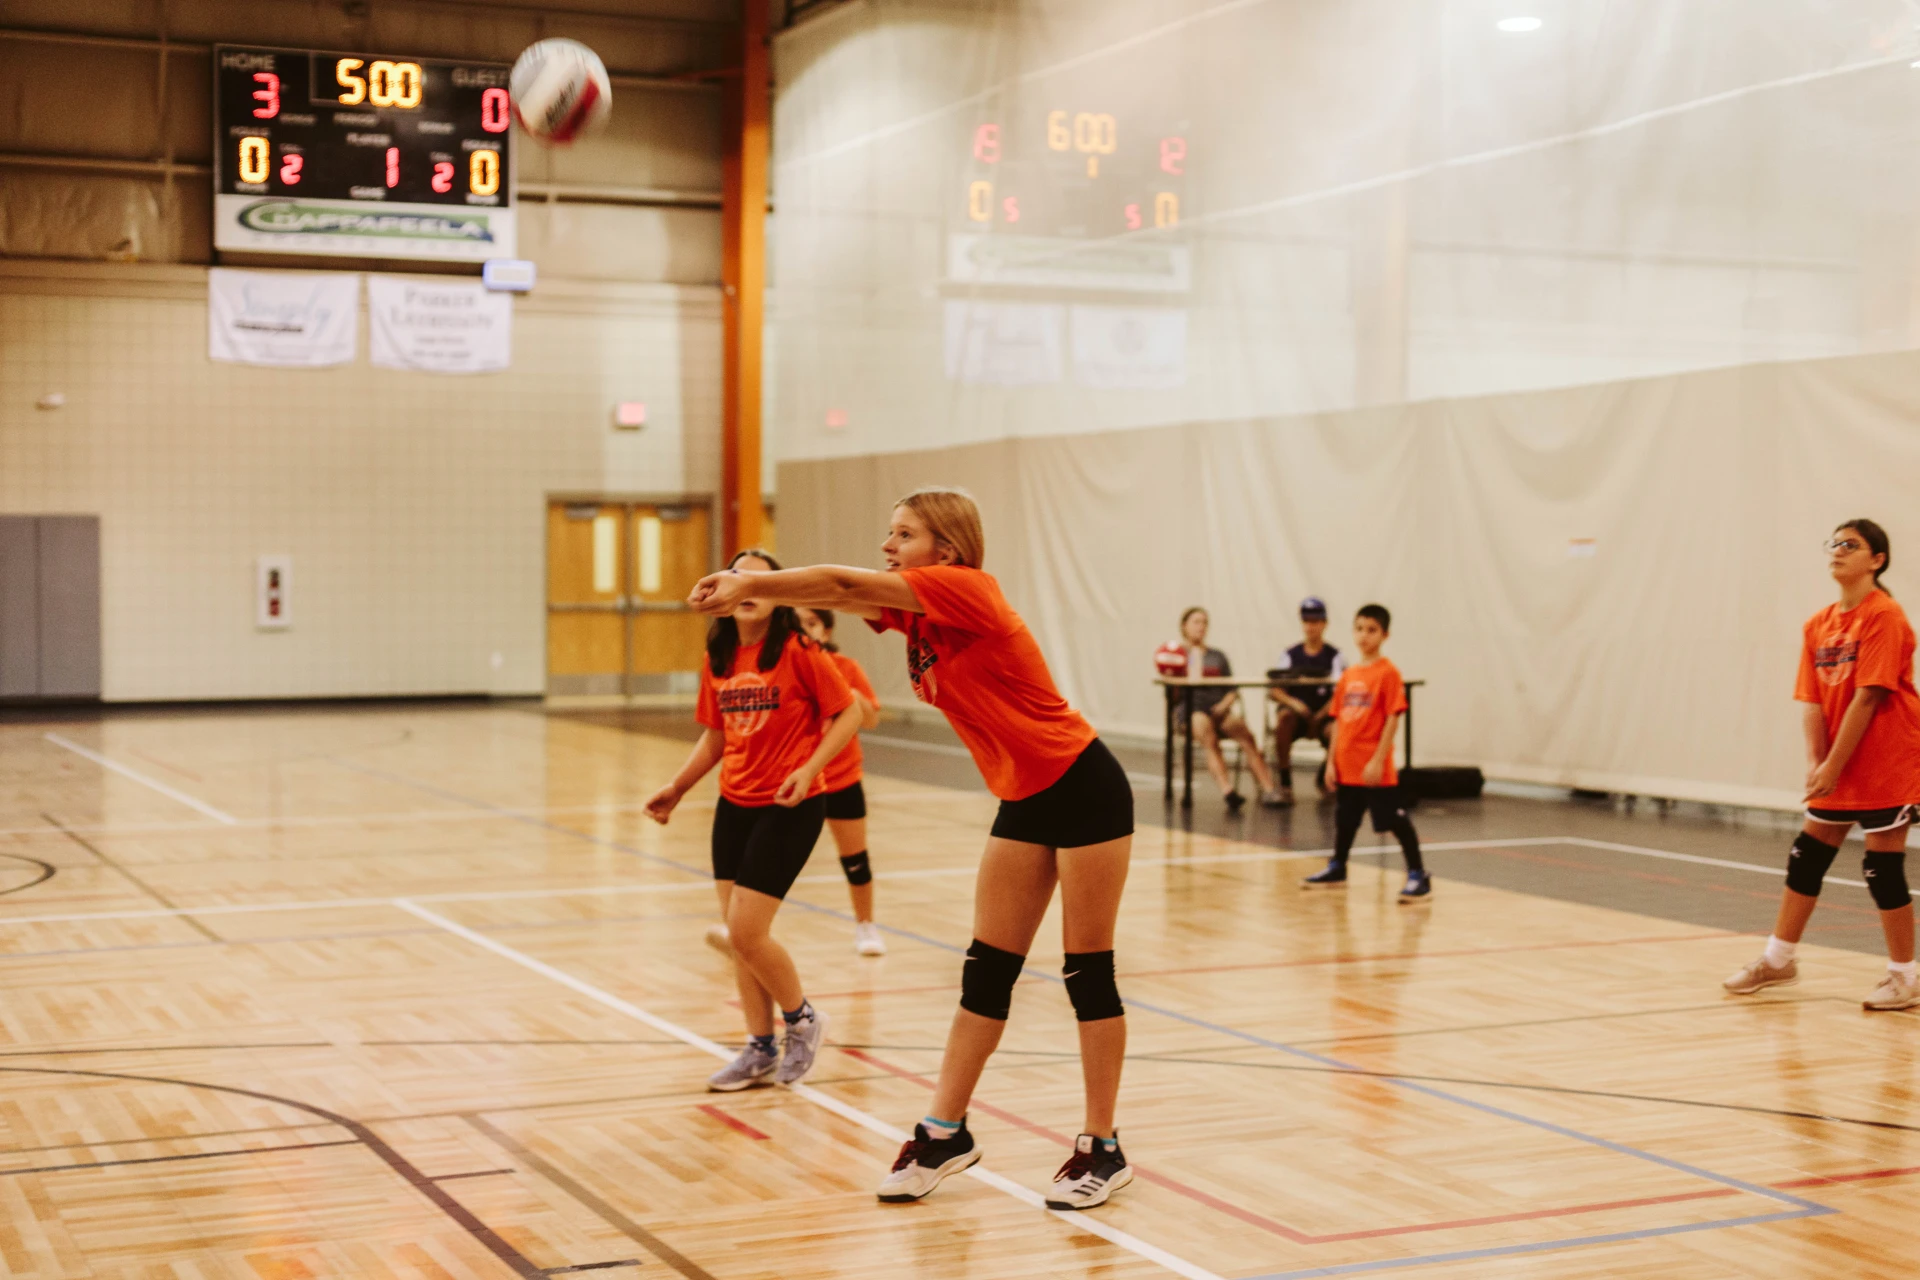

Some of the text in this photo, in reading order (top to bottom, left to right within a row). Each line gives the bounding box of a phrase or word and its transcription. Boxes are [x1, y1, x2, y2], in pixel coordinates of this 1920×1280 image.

[221, 54, 275, 71] HOME
[252, 72, 280, 119] 3
[482, 88, 510, 133] 0
[239, 136, 270, 184] 0
[280, 153, 304, 185] 2
[386, 147, 399, 189] 1
[431, 162, 455, 193] 2
[470, 149, 499, 196] 0
[969, 180, 992, 222] 0
